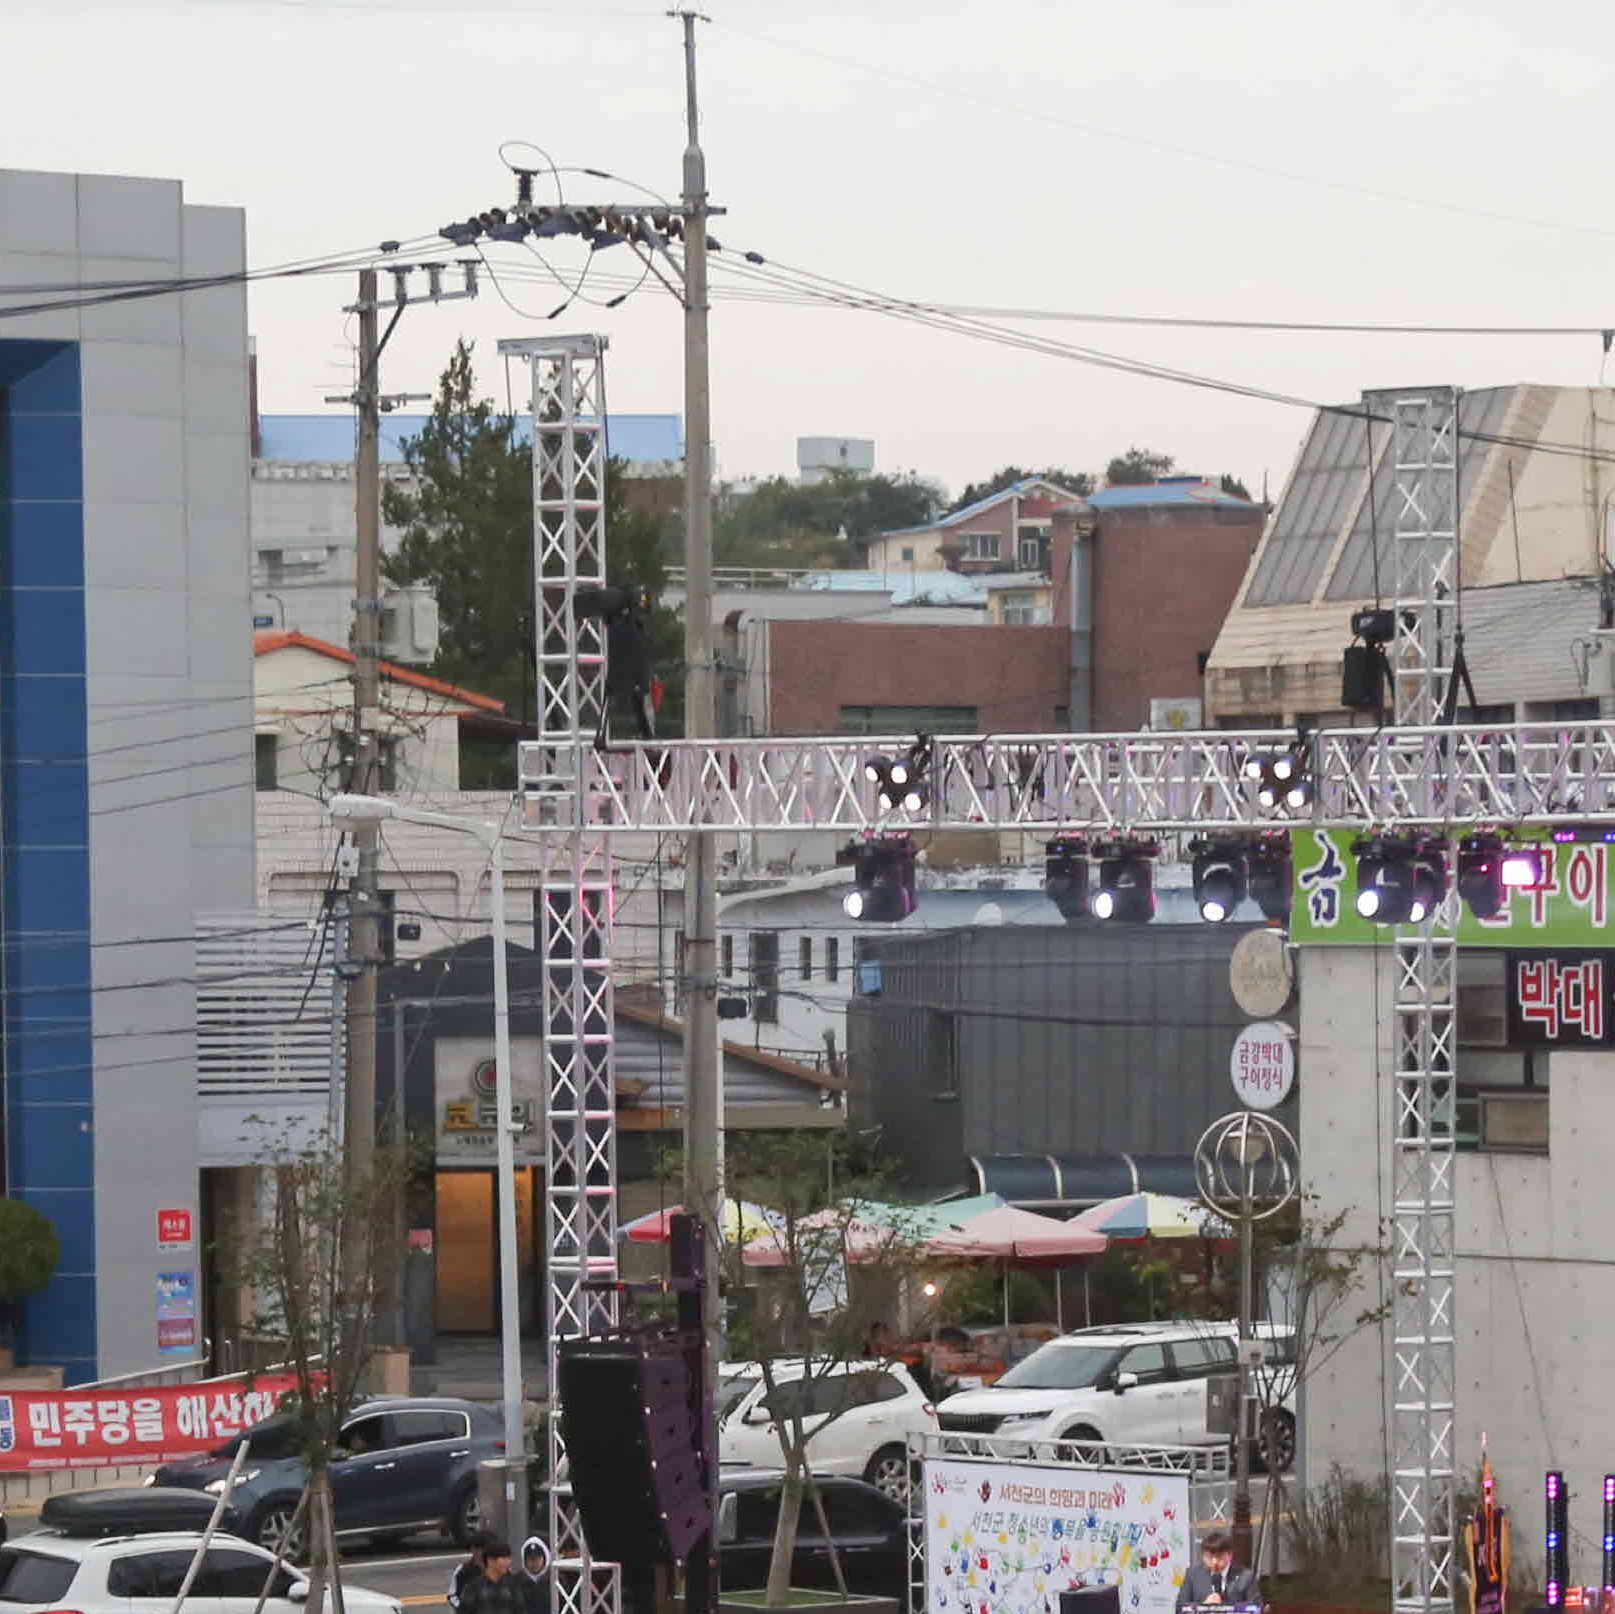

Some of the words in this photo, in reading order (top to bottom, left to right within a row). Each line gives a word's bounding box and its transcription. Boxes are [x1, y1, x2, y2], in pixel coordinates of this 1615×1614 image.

[1519, 958, 1603, 1039] 박대
[1240, 1040, 1283, 1065] 금강박대
[1240, 1066, 1283, 1090] 구이정식
[28, 1396, 165, 1447] 민주당을
[176, 1388, 282, 1440] 해산하
